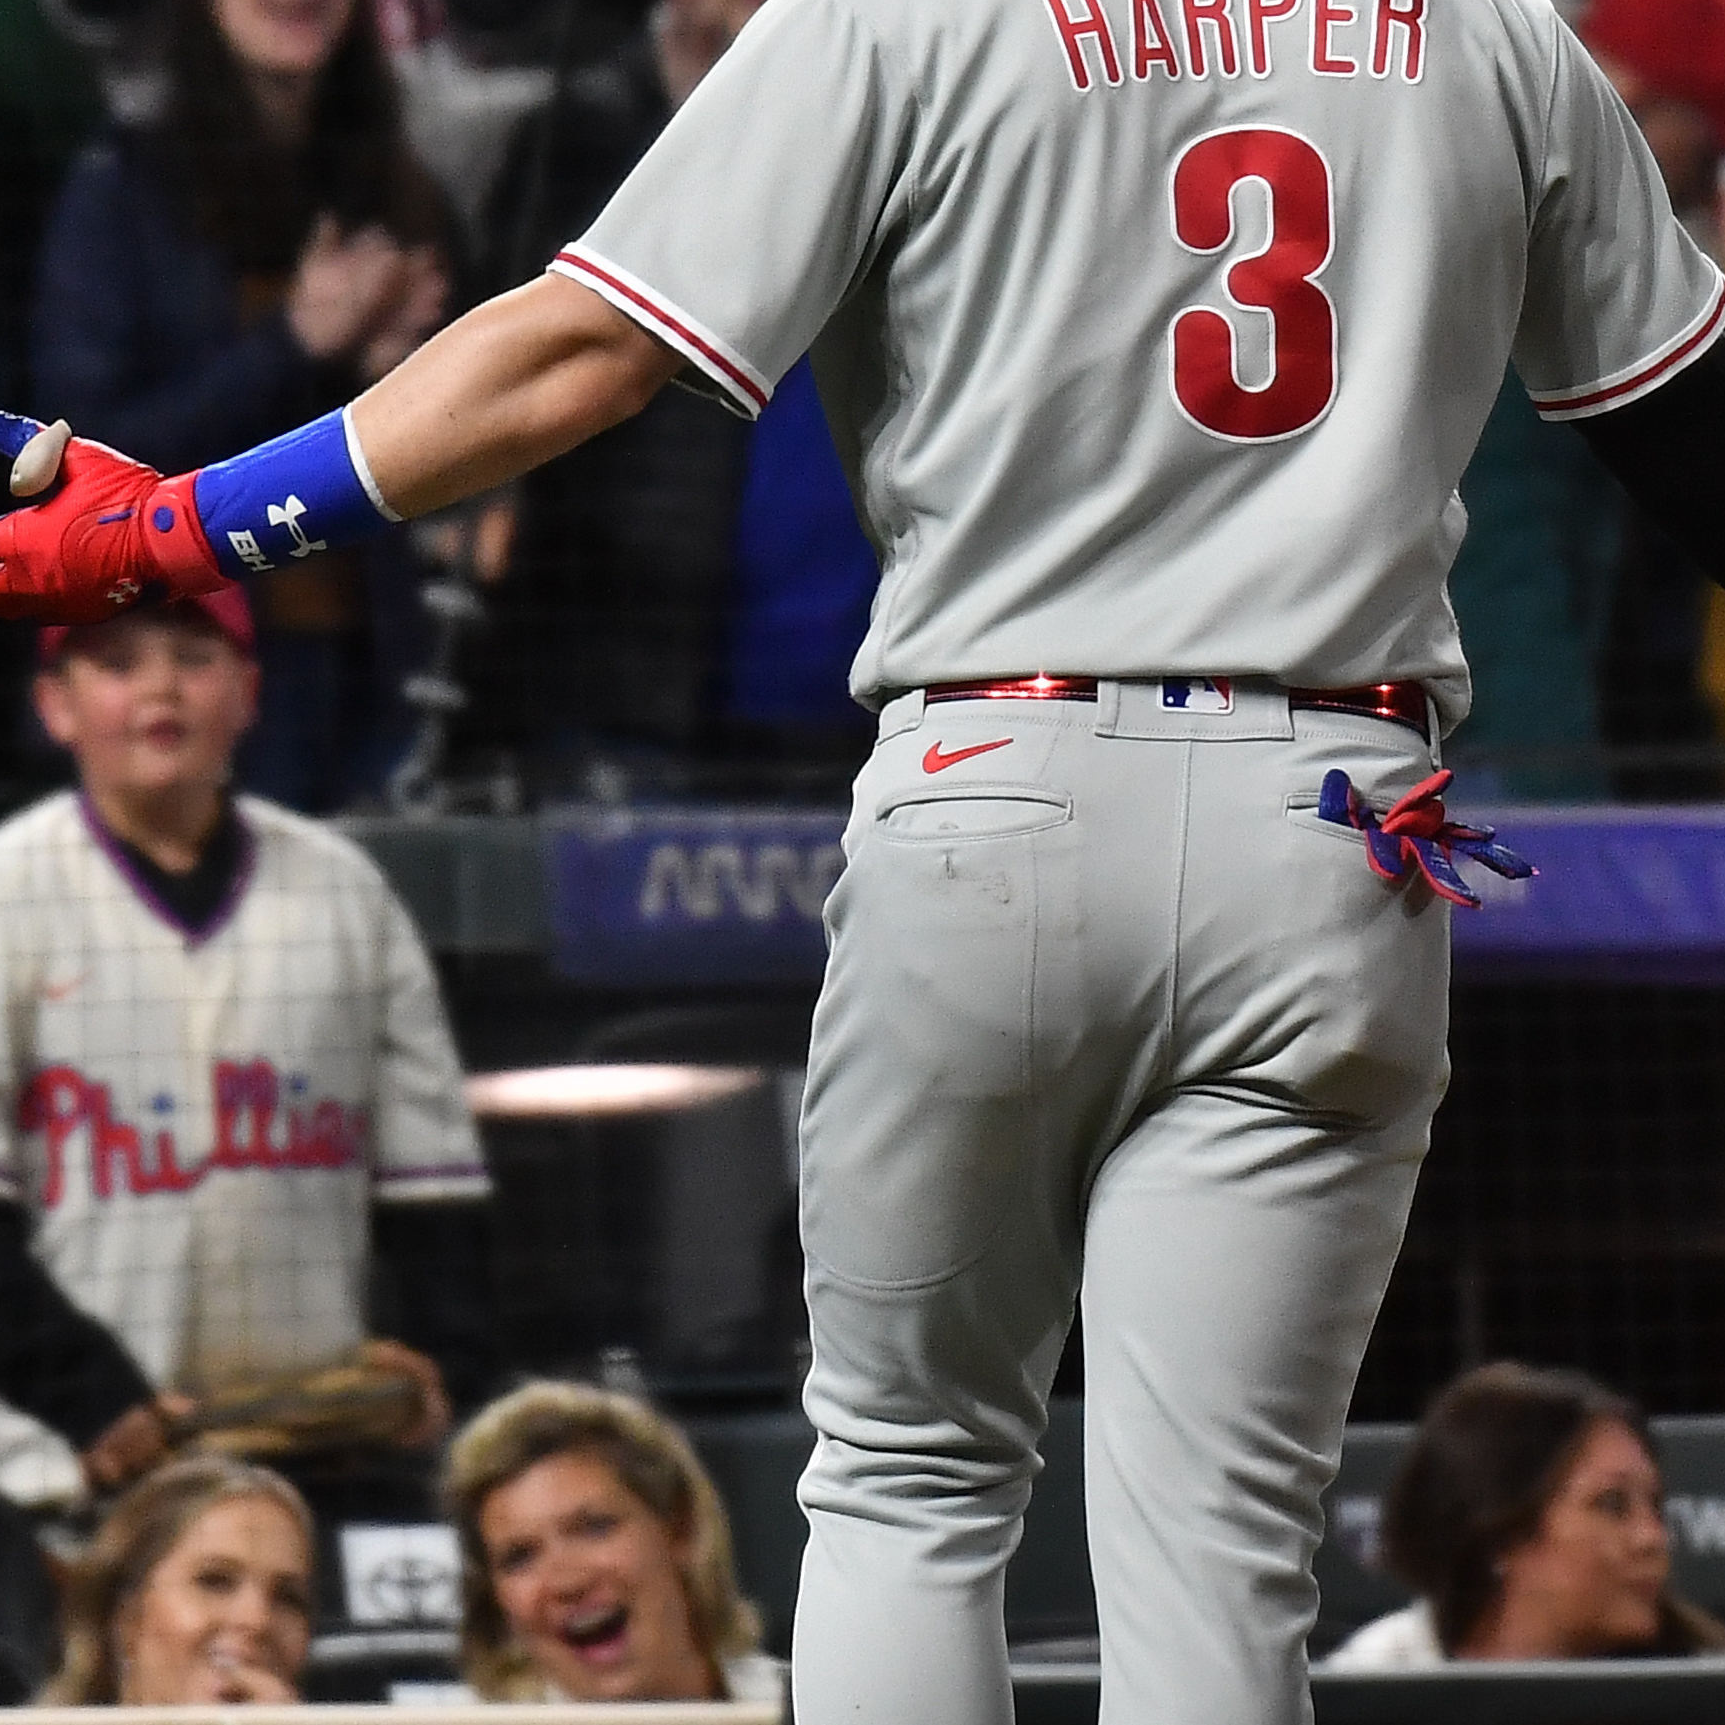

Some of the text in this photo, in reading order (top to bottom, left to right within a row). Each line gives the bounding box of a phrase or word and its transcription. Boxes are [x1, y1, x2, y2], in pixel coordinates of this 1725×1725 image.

[1167, 123, 1339, 444] 3
[226, 528, 276, 572] BH
[18, 1056, 370, 1212] Phillies
